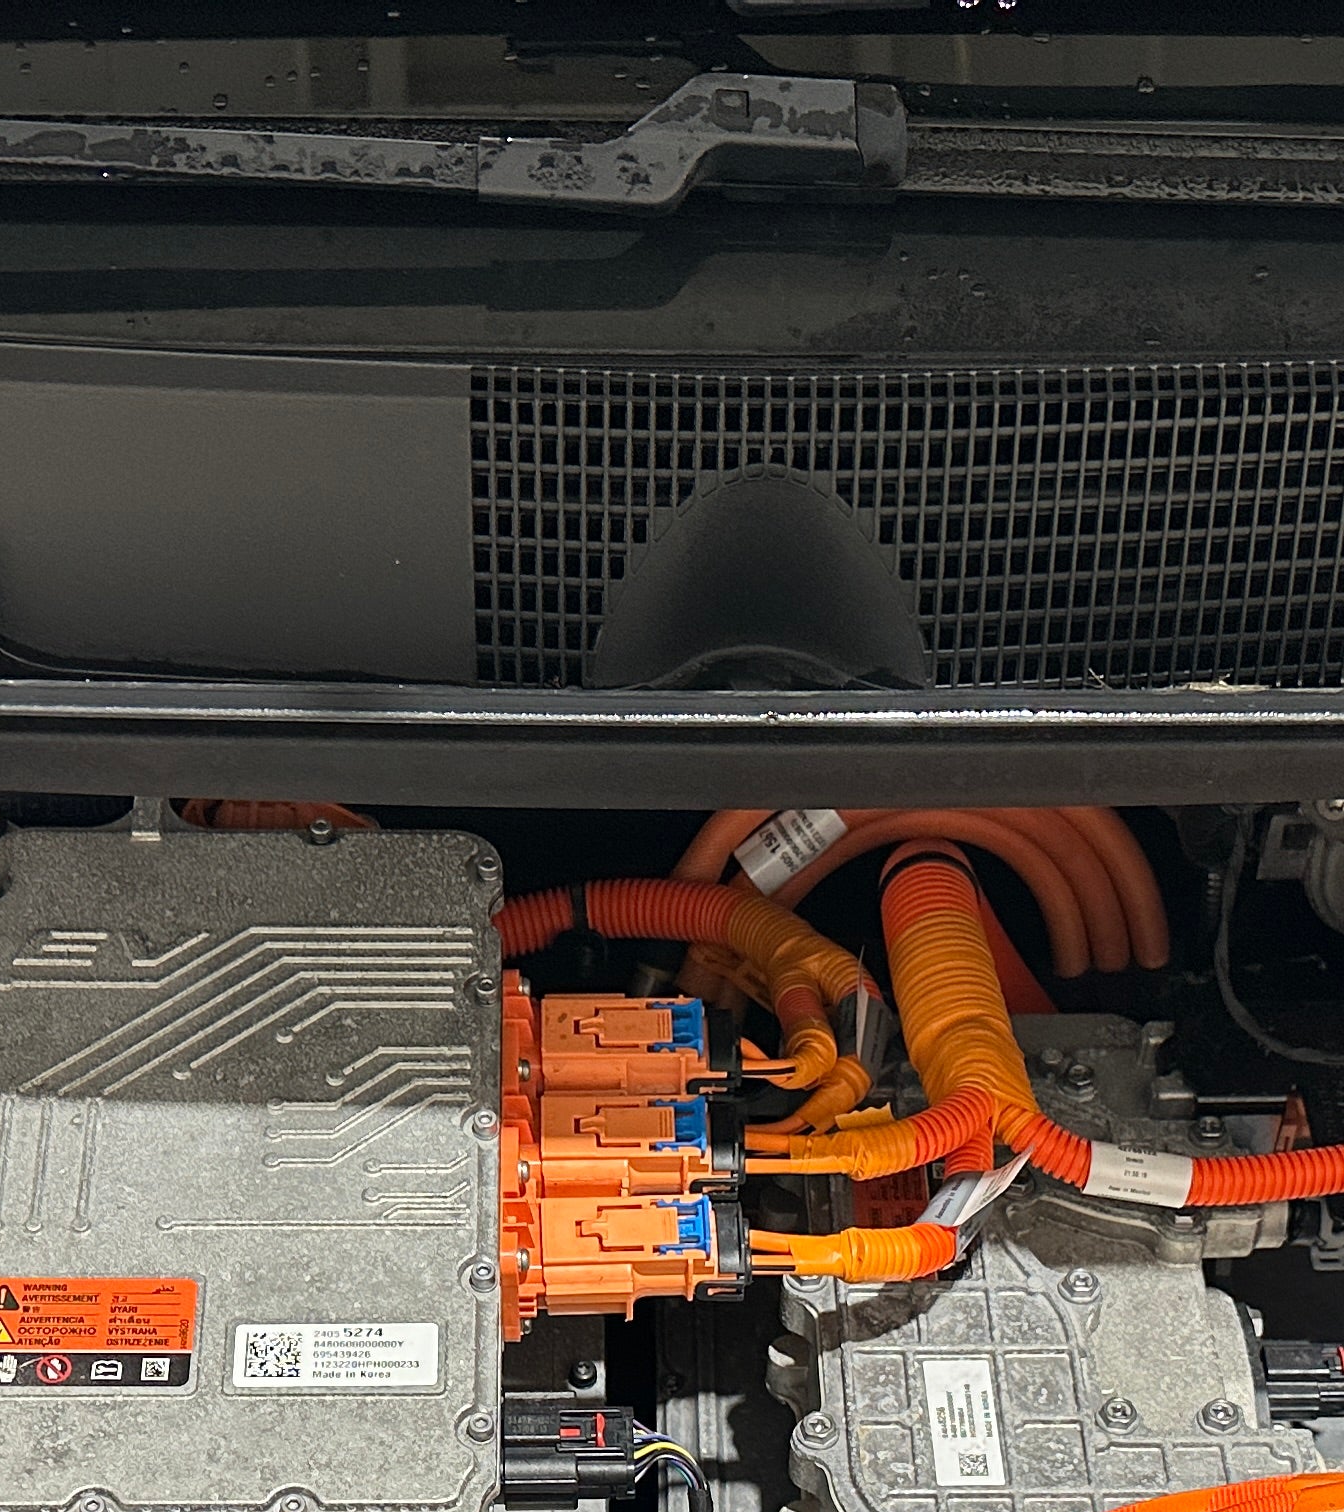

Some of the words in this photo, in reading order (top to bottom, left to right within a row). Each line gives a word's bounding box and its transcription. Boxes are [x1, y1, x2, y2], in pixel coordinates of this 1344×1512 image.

[23, 1283, 67, 1291] WARNING
[21, 1294, 98, 1302] AVERTISSEMENT
[109, 1305, 137, 1313] UYARI
[17, 1326, 96, 1334] ОСТОРОЖНО
[343, 1327, 382, 1337] 5274
